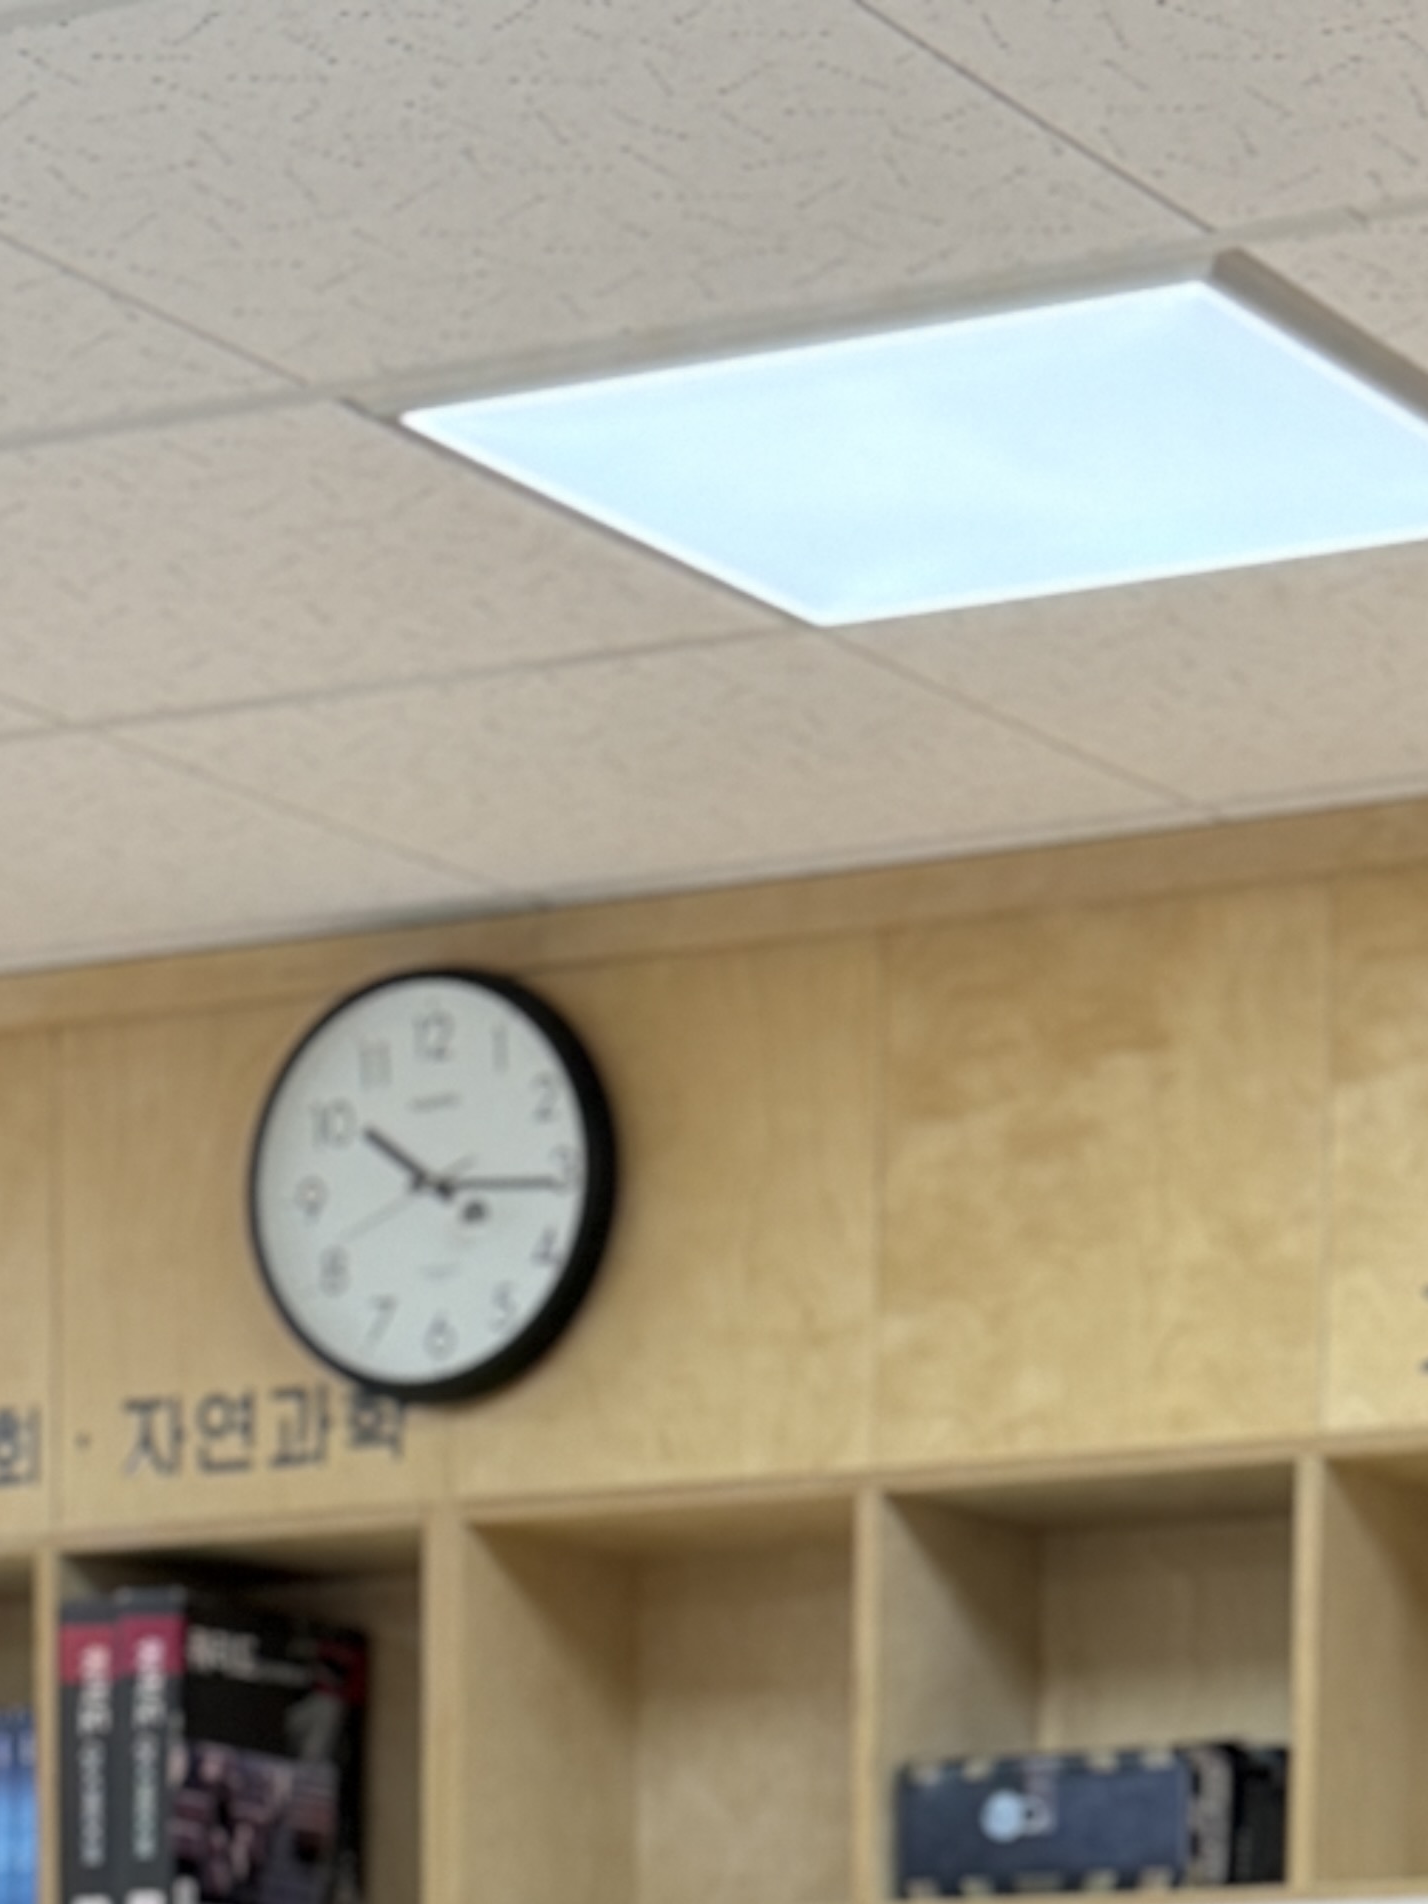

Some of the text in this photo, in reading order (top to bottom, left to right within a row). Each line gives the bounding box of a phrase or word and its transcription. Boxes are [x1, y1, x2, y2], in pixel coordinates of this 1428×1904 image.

[415, 1010, 454, 1063] 12
[533, 1071, 557, 1122] 2
[312, 1099, 356, 1148] 10
[423, 1312, 458, 1360] 6
[119, 1382, 410, 1478] 자연과학
